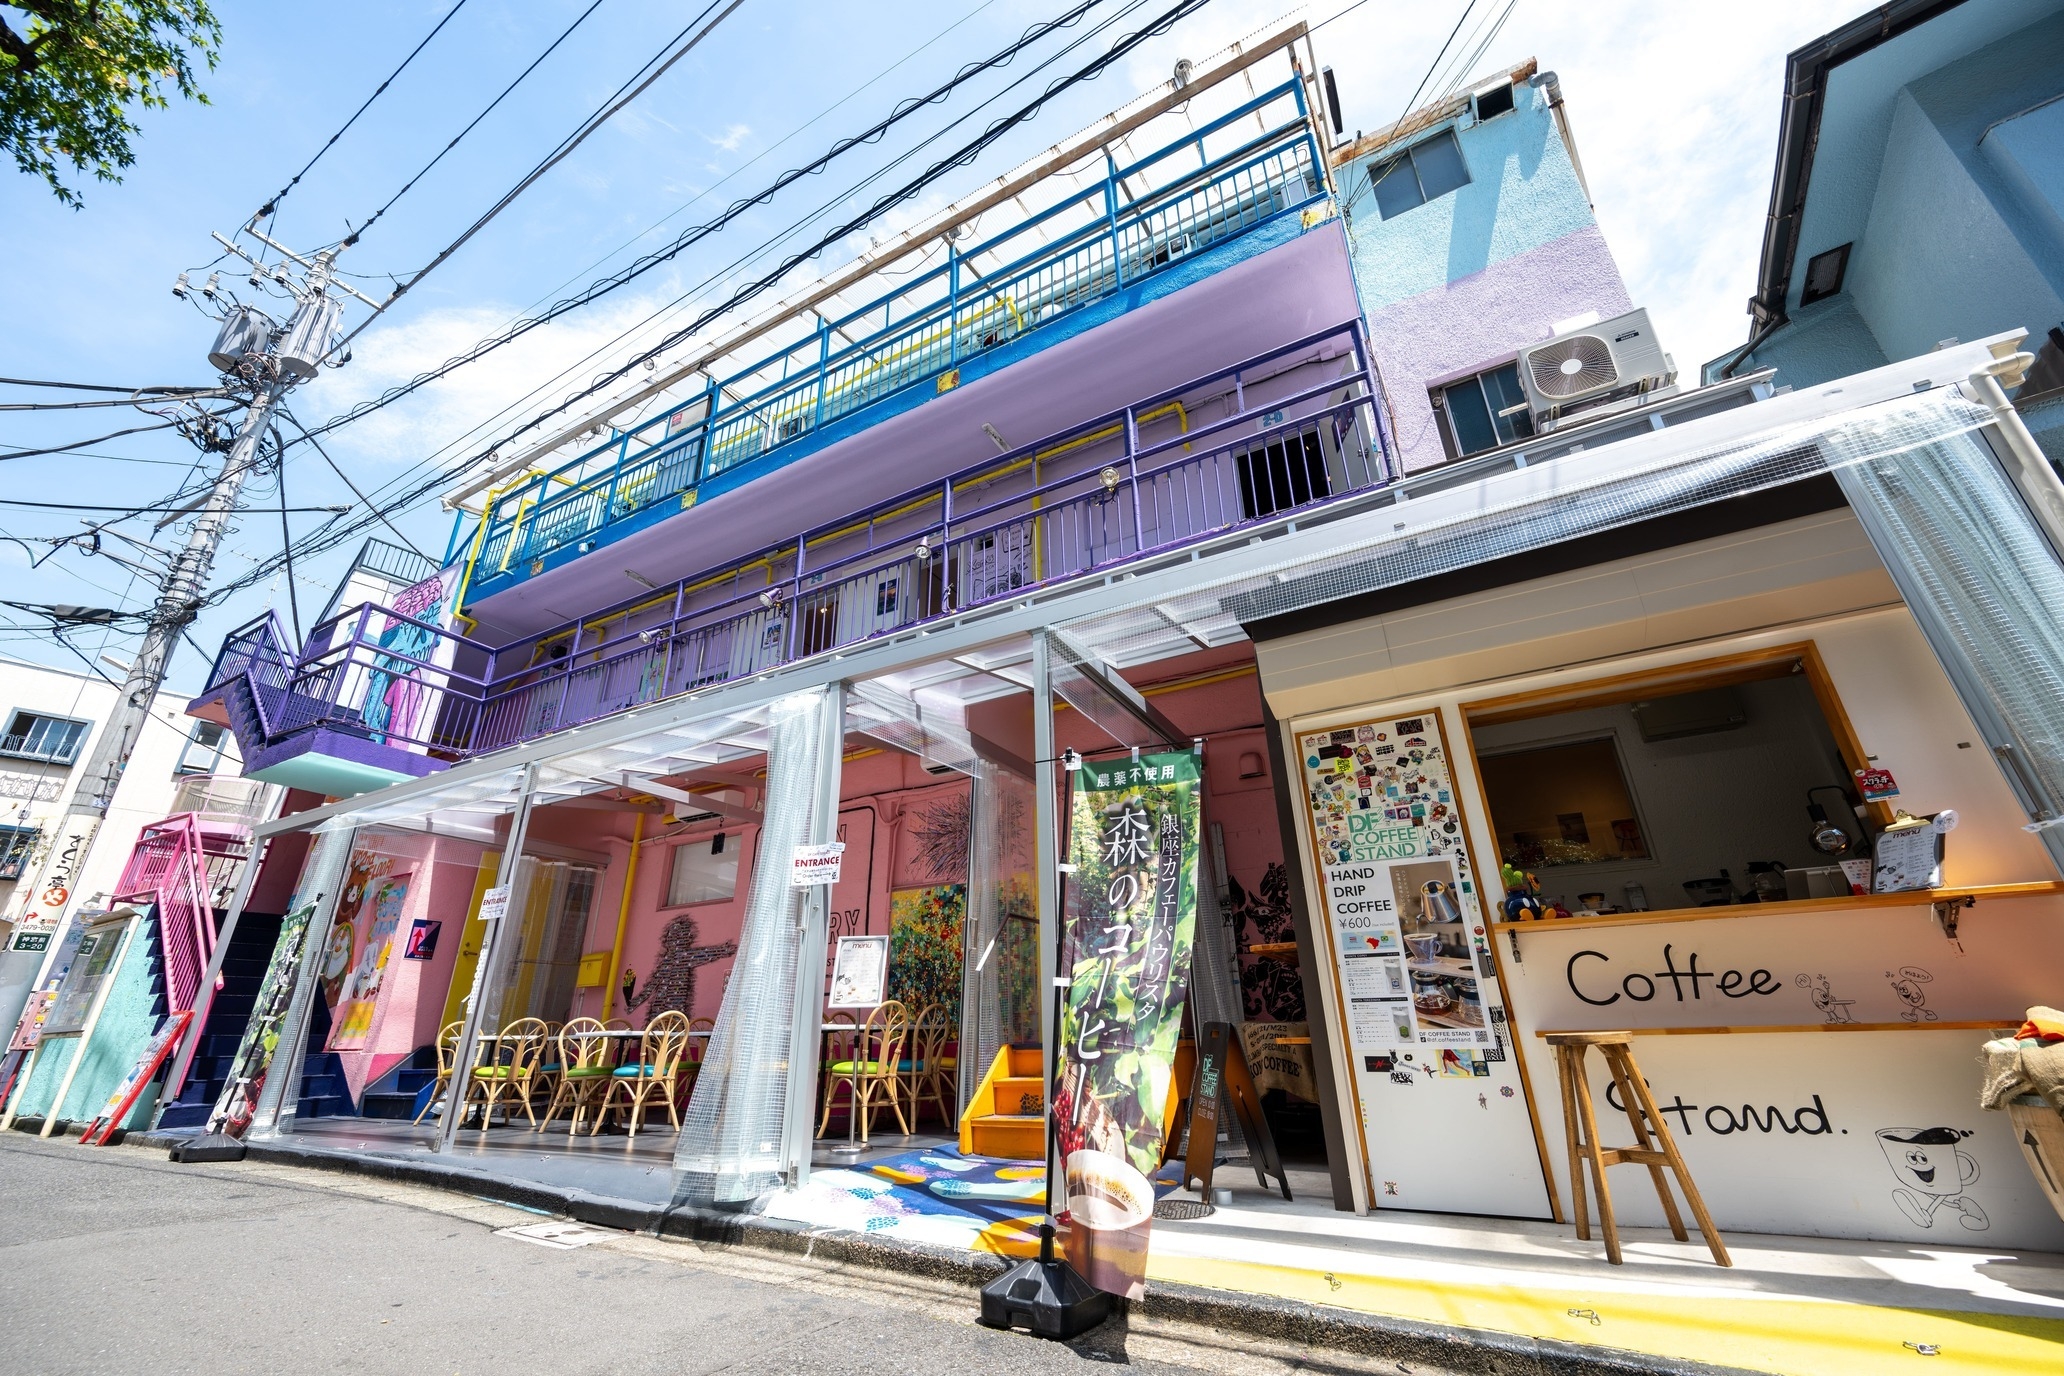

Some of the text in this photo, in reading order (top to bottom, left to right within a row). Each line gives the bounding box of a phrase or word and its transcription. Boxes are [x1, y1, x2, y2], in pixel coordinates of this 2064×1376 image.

[1097, 764, 1175, 788] 農薬不使用
[1862, 775, 1890, 787] スクラッチ
[1353, 827, 1418, 846] COFFEE
[1355, 842, 1416, 861] STAND
[794, 856, 840, 867] ENTRANCE
[1331, 867, 1375, 882] HAND
[1333, 885, 1366, 898] DRIP
[1336, 899, 1392, 914] COFFEE
[1137, 813, 1180, 1022] 銀座カフェーパウリスタ
[1339, 916, 1371, 929] ¥600
[1072, 807, 1151, 1126] 森のコーヒー
[1566, 943, 1782, 1006] Coffee
